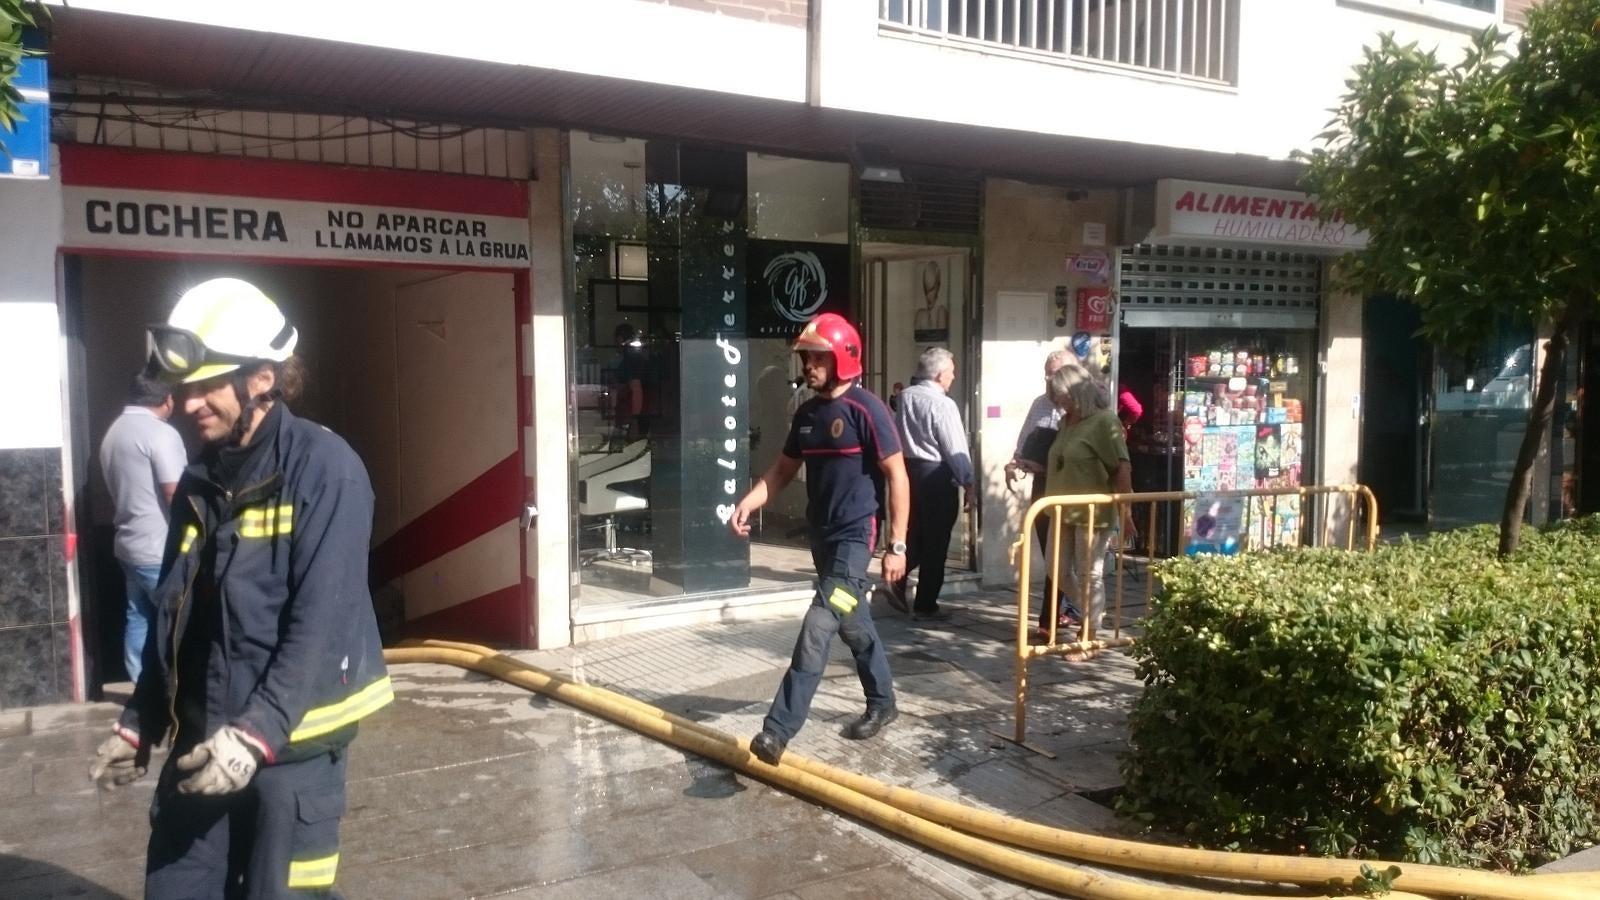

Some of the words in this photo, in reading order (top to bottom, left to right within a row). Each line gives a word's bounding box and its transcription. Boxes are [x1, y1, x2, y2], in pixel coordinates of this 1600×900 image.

[86, 200, 289, 242] COCHERA
[1176, 191, 1349, 223] ALIMENTAI
[327, 210, 364, 228] NO
[376, 213, 487, 237] APARCAR
[315, 230, 432, 253] LLAMAMOS
[440, 239, 449, 254] A
[456, 240, 475, 257] LA
[480, 241, 529, 260] GRUA
[228, 757, 251, 777] 165
